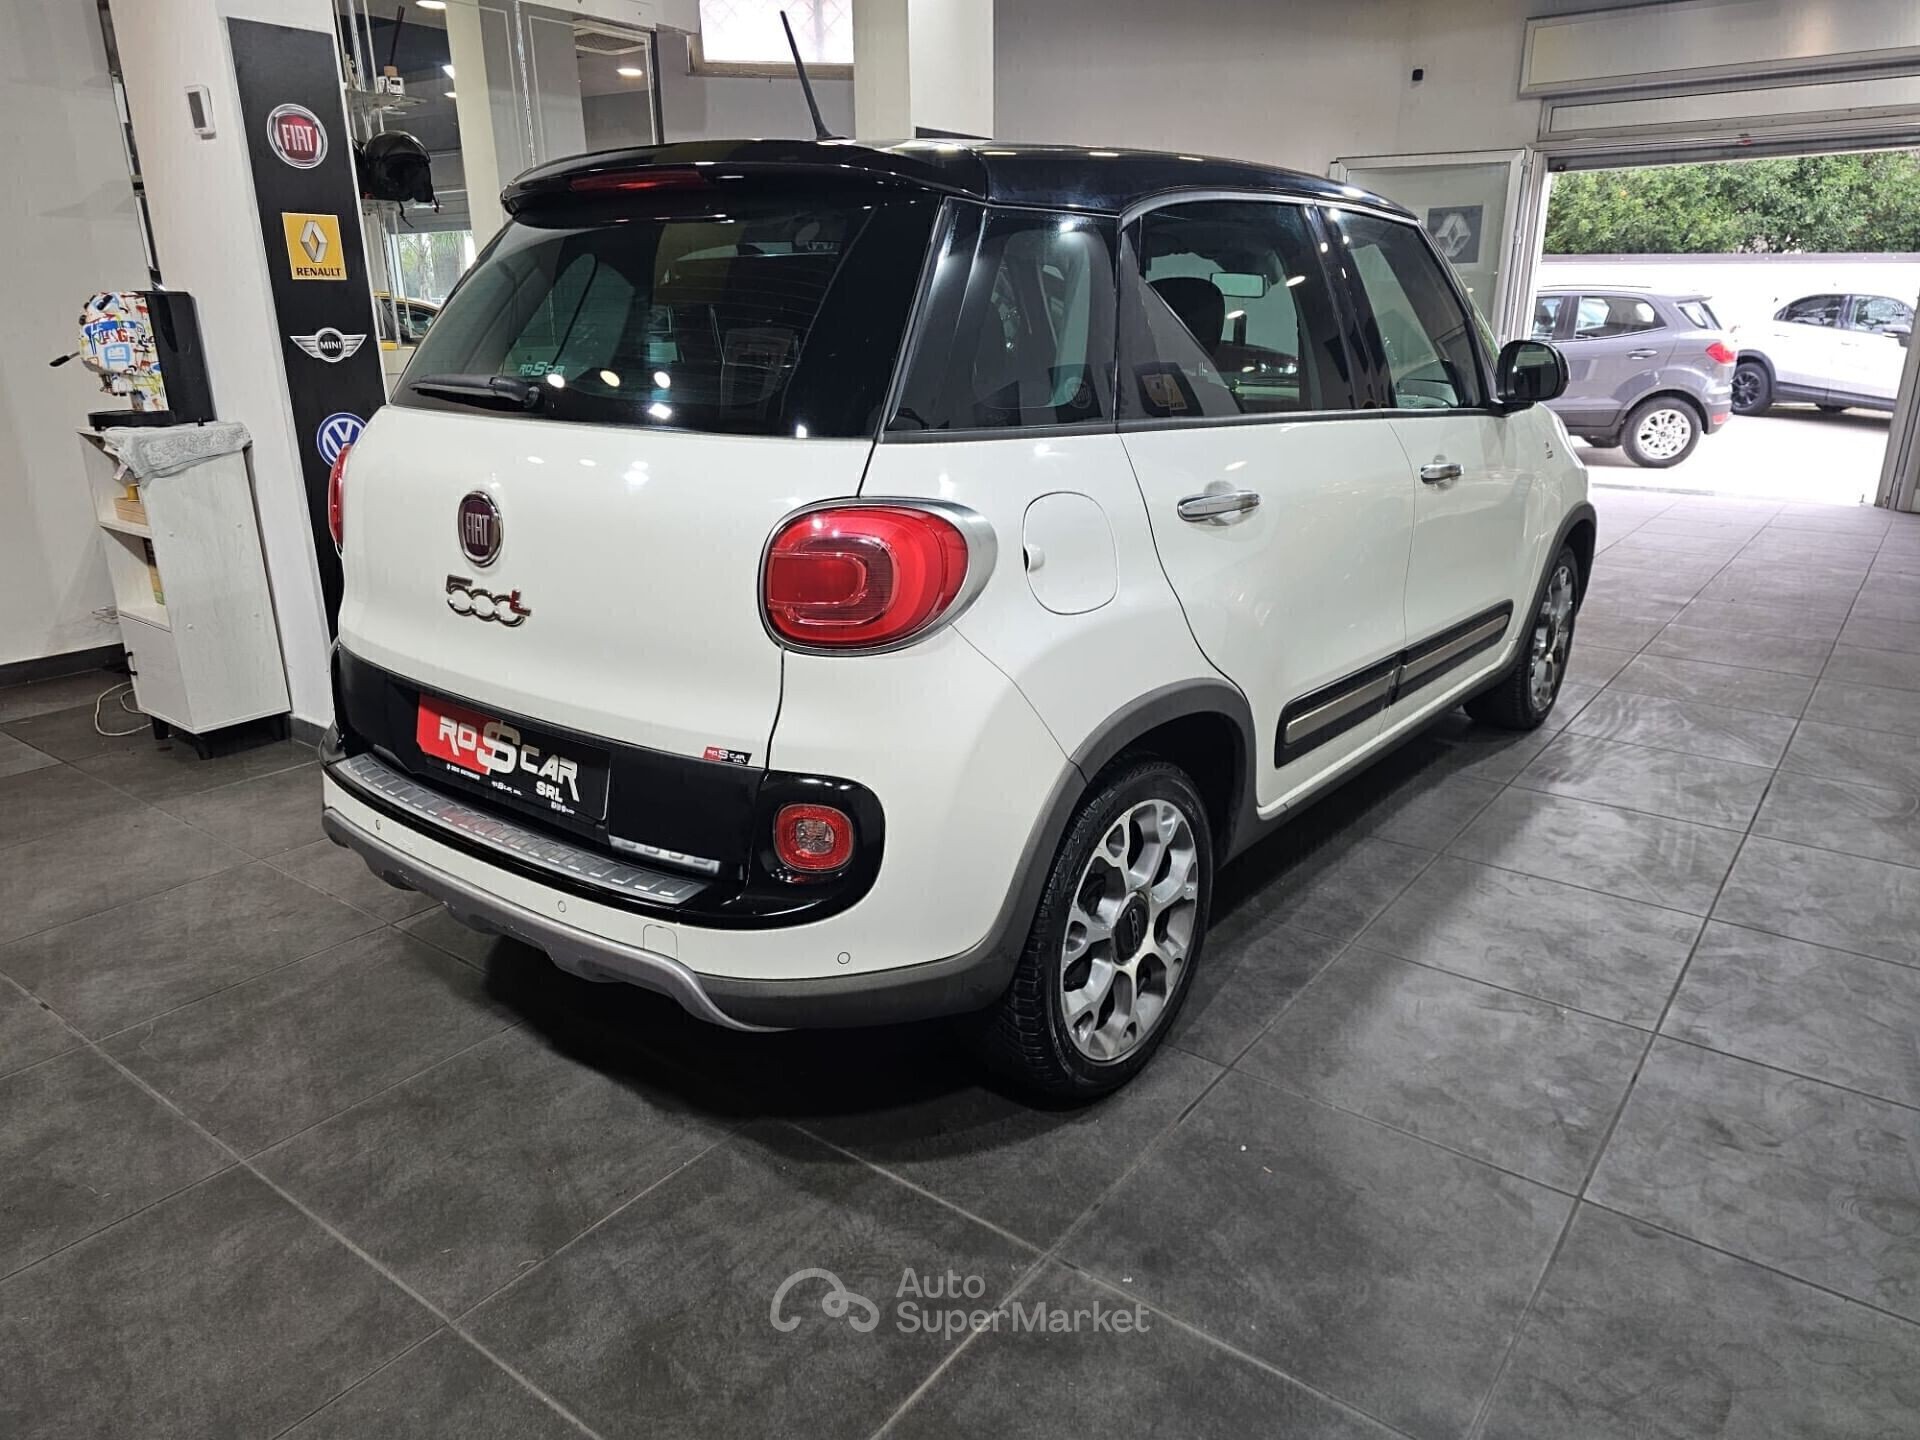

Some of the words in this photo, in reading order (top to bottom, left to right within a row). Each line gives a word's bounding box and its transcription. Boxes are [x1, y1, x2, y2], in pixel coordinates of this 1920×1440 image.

[281, 124, 313, 152] FIAT
[296, 267, 341, 277] RENAULT
[320, 340, 342, 350] MINI
[465, 512, 490, 546] FIAT
[536, 780, 563, 803] SRL
